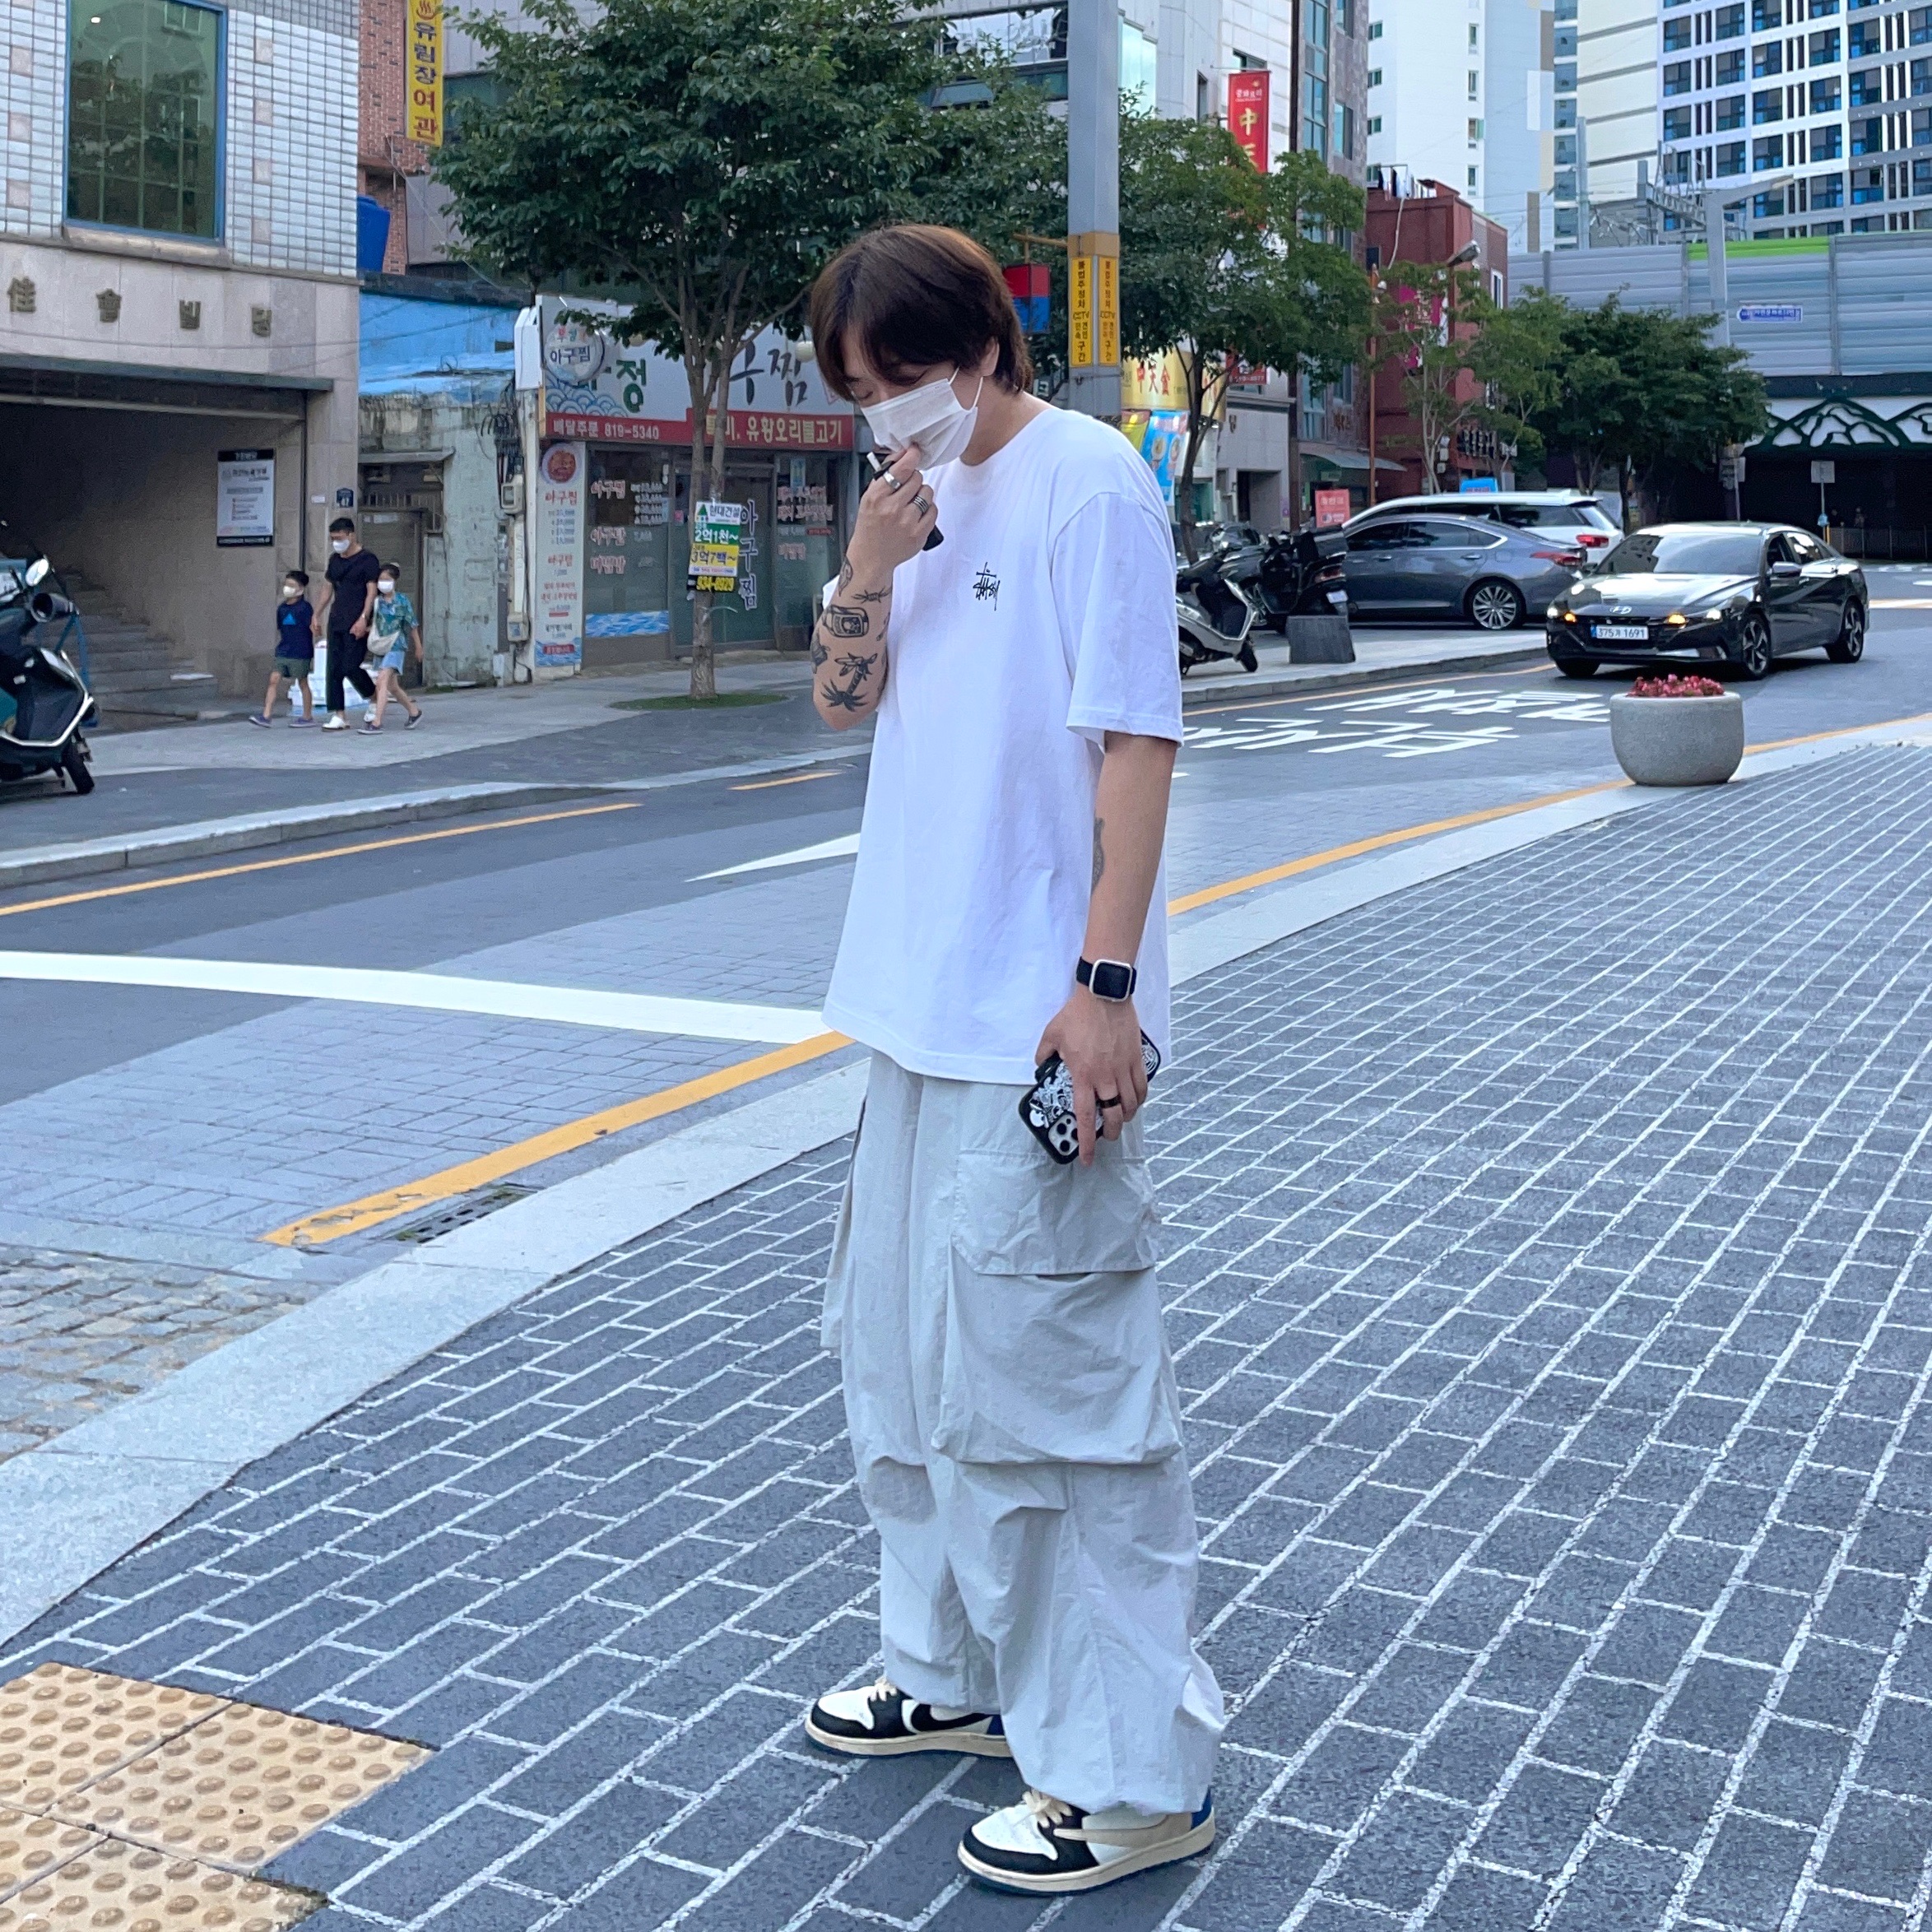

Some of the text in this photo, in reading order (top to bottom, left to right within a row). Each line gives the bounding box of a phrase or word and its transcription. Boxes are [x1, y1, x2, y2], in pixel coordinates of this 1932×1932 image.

[1072, 311, 1089, 321] CCTV
[550, 345, 591, 365] 아구찜
[729, 338, 808, 406] 구찜
[553, 418, 599, 439] 배달주문
[604, 423, 659, 440] 819-5340
[746, 416, 842, 445] 유황오리불고기
[738, 498, 759, 611] 아구찜
[1623, 628, 1645, 639] 1691
